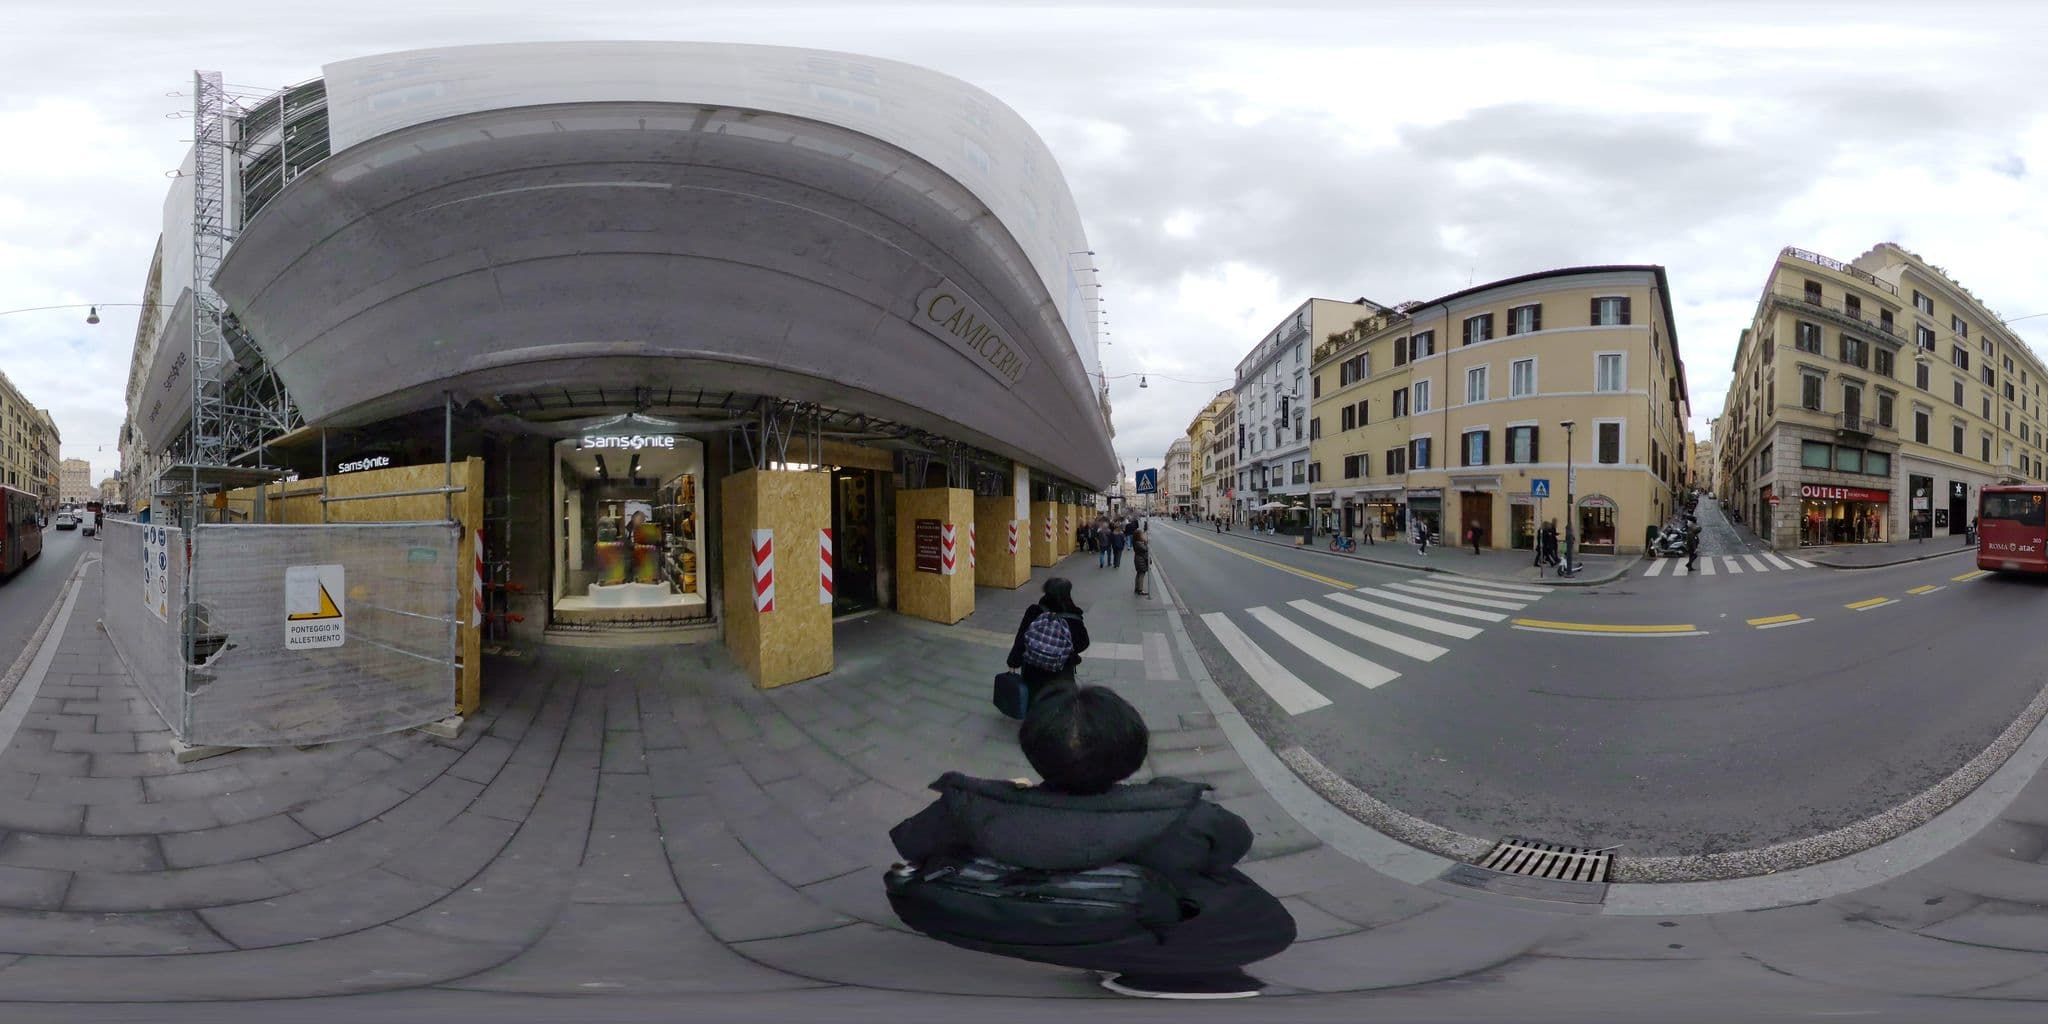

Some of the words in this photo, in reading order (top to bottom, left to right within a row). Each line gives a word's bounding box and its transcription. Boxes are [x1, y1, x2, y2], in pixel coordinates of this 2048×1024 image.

[927, 293, 1023, 382] CAMICERIA
[583, 434, 675, 450] Samsonite
[338, 456, 390, 473] Samsonite
[1801, 485, 1849, 499] OUTLET
[1988, 542, 2008, 550] ROMA
[2018, 544, 2036, 552] atac
[290, 624, 331, 633] PONTEGGIO
[332, 623, 340, 631] IN
[290, 634, 341, 644] ALLESTIMENTO
